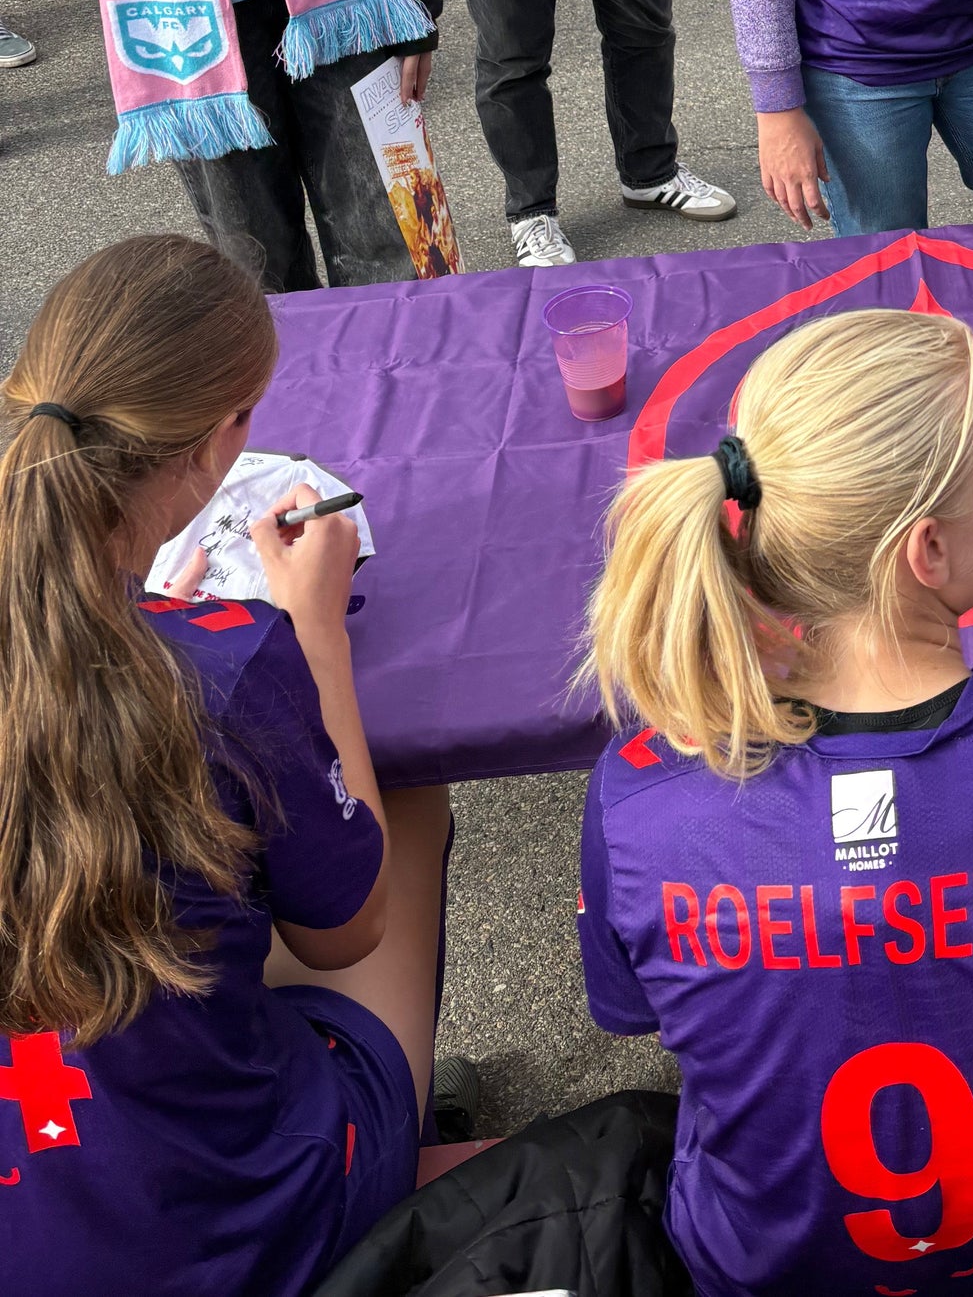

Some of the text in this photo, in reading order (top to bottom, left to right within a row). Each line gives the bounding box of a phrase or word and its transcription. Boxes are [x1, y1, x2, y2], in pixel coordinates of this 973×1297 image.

[126, 4, 208, 18] CALGARY
[162, 20, 180, 31] FC
[834, 842, 899, 861] MAILLOT
[848, 859, 886, 872] HOMES
